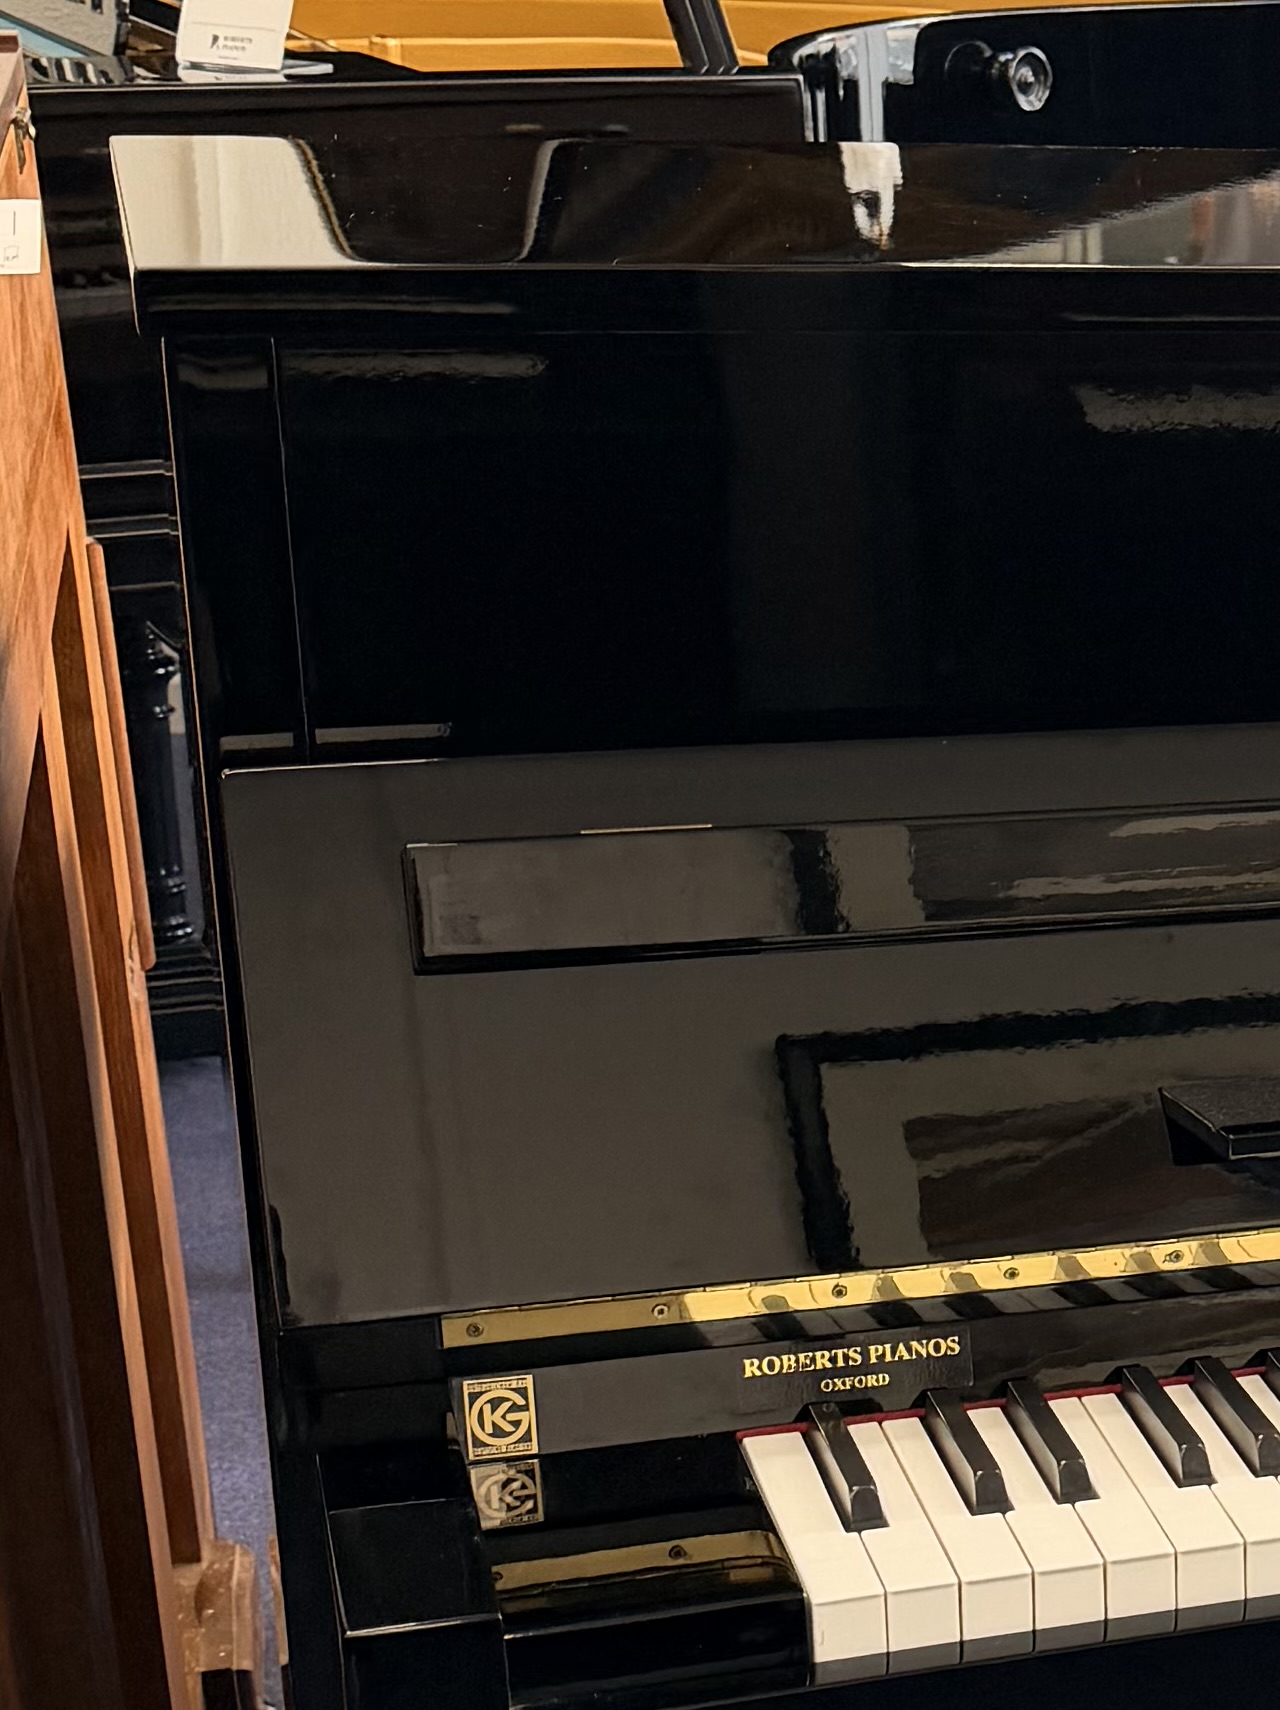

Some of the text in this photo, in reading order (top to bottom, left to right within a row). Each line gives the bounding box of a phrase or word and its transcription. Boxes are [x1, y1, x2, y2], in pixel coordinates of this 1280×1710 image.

[743, 1336, 960, 1378] ROBERTS PIANOS
[821, 1373, 890, 1392] OXFORD
